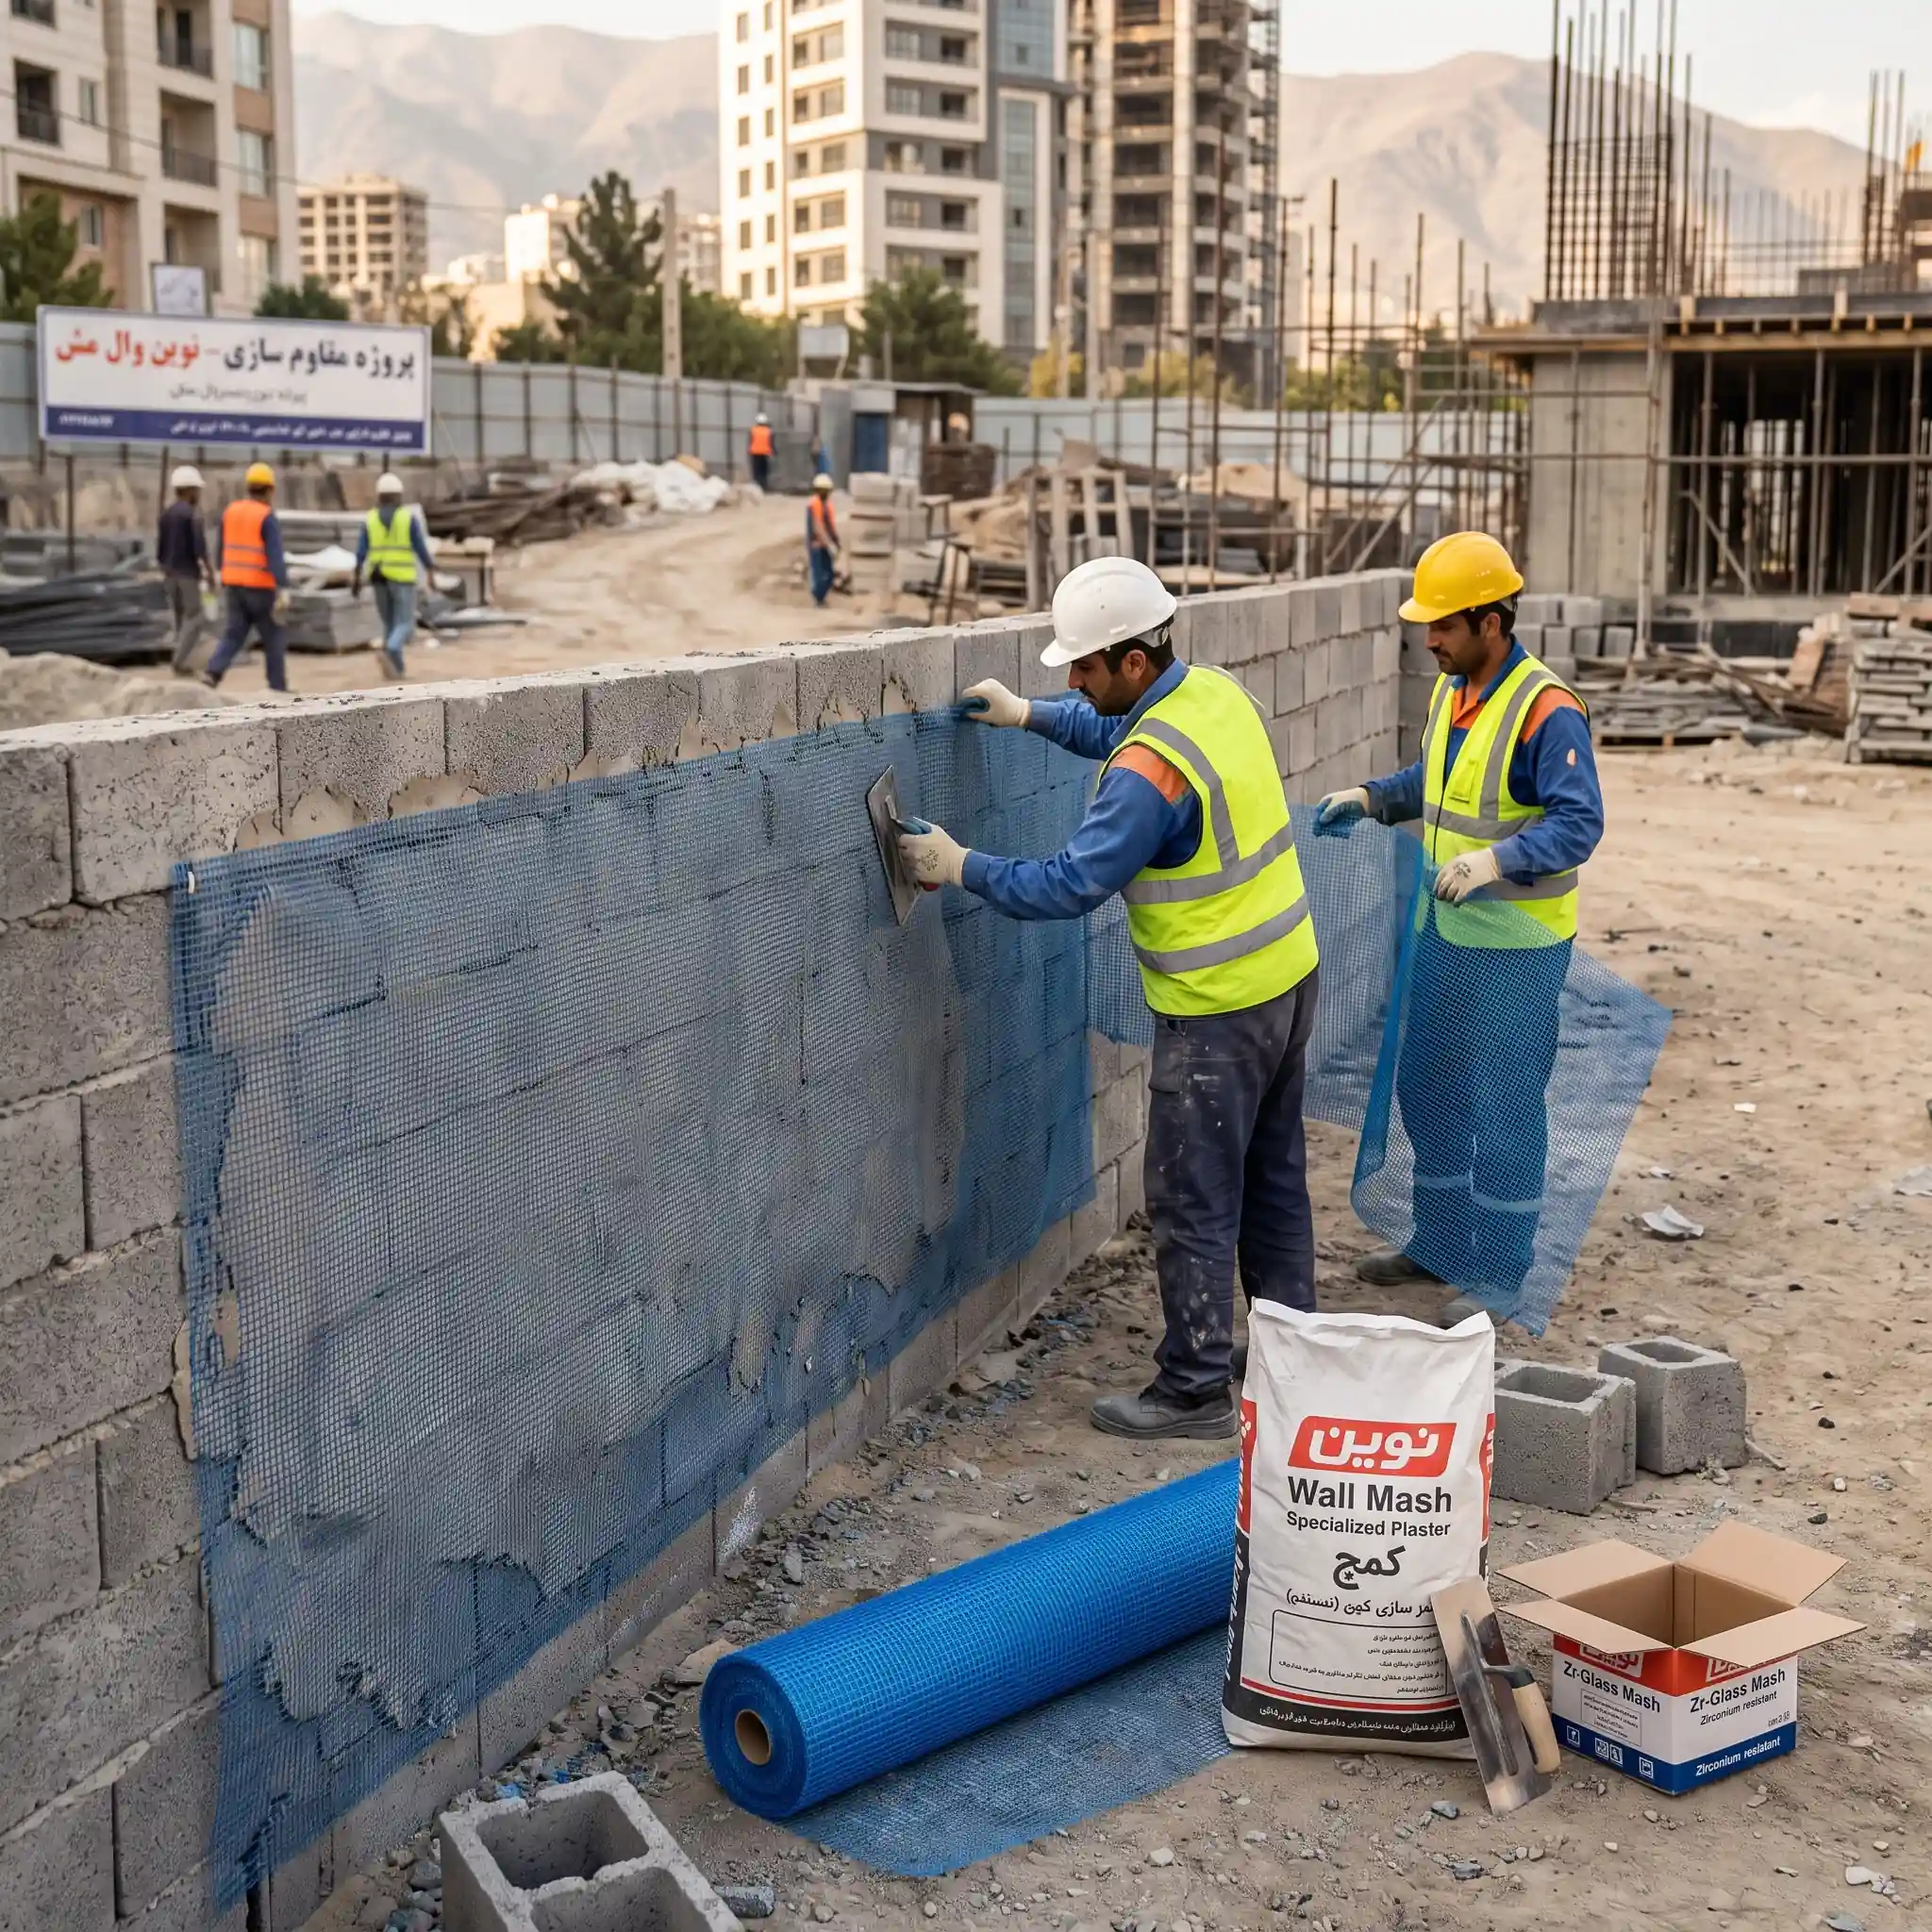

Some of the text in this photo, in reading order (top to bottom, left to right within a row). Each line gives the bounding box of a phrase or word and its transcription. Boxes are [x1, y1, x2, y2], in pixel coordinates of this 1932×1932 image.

[106, 329, 144, 367] وال
[151, 333, 200, 369] نوین
[224, 338, 283, 371] سازی
[290, 341, 348, 374] مقاوم
[355, 345, 415, 379] پروژه
[1309, 1426, 1440, 1470] نوین
[1288, 1475, 1452, 1513] Wall Mash
[1287, 1510, 1451, 1537] Specialized Plaster
[1376, 1600, 1412, 1618] سازی
[1564, 1660, 1660, 1713] Zr-Glass Mash
[1690, 1669, 1786, 1713] Zr-Glass Mash
[1700, 1690, 1777, 1726] Zirconium resistant
[1695, 1753, 1741, 1777] Zirconium
